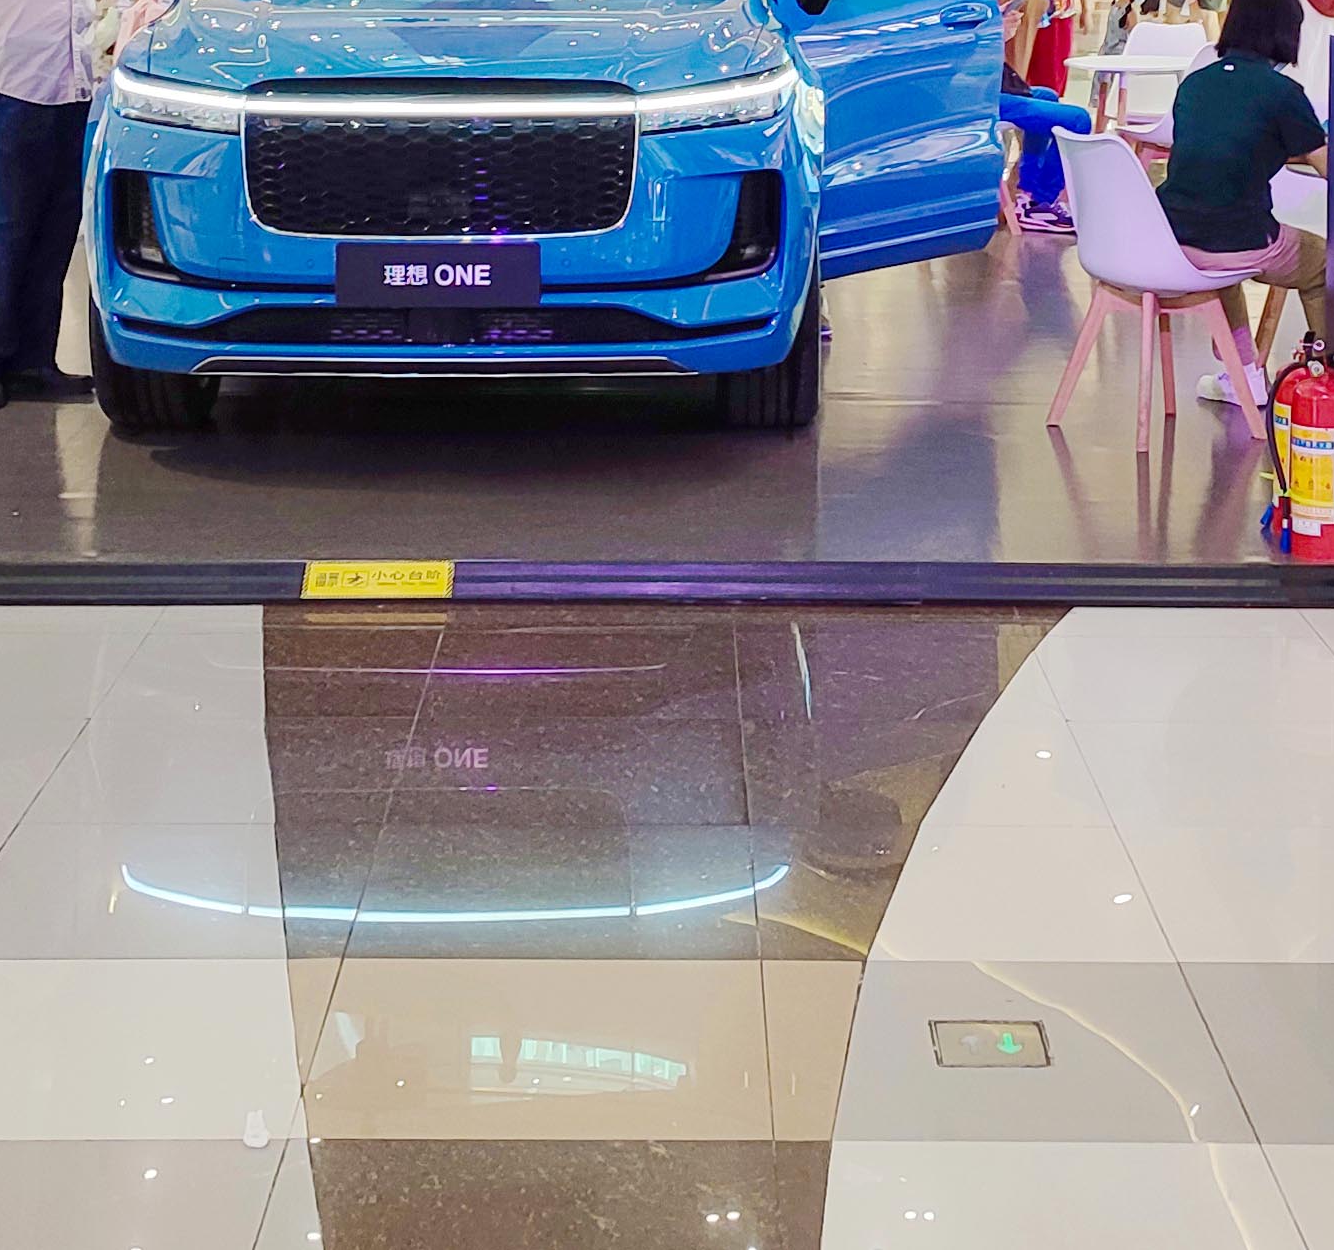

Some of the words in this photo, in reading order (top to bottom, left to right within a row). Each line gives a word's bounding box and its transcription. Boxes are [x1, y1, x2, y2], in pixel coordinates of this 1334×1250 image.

[383, 264, 428, 286] 理想
[434, 264, 491, 286] ONE
[371, 570, 441, 581] 小心台阶
